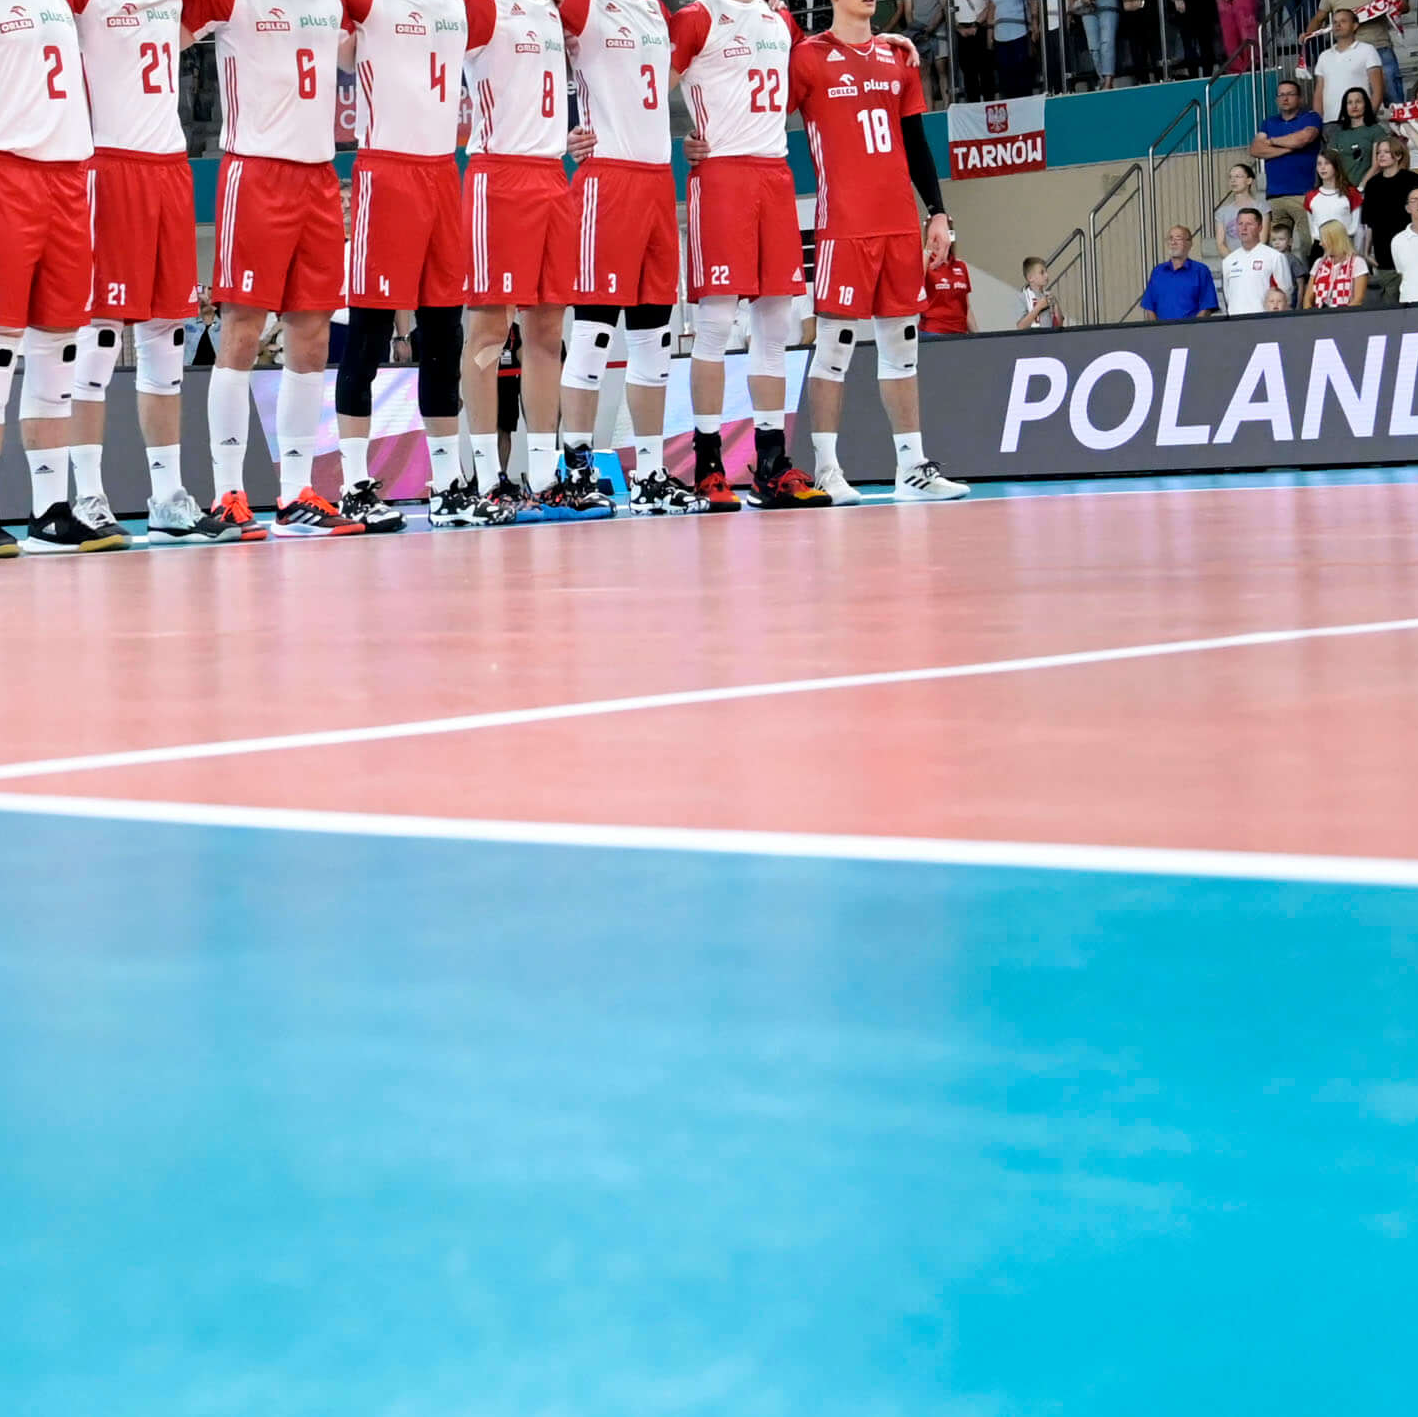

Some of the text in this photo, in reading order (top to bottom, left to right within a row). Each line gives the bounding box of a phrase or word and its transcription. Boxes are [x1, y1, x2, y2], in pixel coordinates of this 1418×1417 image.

[1, 19, 33, 32] ORLEN
[40, 11, 64, 25] plus
[109, 17, 138, 27] ORLEN
[146, 9, 170, 23] plus
[299, 15, 328, 29] plus
[436, 18, 459, 33] plus
[257, 22, 289, 31] ORLEN
[545, 38, 561, 52] plus
[607, 39, 634, 48] ORLEN
[641, 33, 663, 46] plus
[756, 39, 777, 53] plus
[725, 47, 750, 57] ORLEN
[43, 45, 67, 99] 2
[139, 42, 175, 94] 21
[296, 48, 316, 100] 6
[430, 52, 446, 102] 4
[541, 71, 554, 118] 8
[640, 64, 658, 110] 3
[748, 68, 781, 113] 22
[864, 79, 889, 93] plus
[857, 109, 891, 153] 18
[953, 138, 1043, 168] TARNÓW
[242, 271, 253, 292] 6
[502, 273, 512, 292] 8
[608, 274, 616, 293] 3
[711, 266, 729, 285] 22
[108, 283, 126, 305] 21
[379, 277, 389, 296] 4
[839, 286, 853, 304] 18
